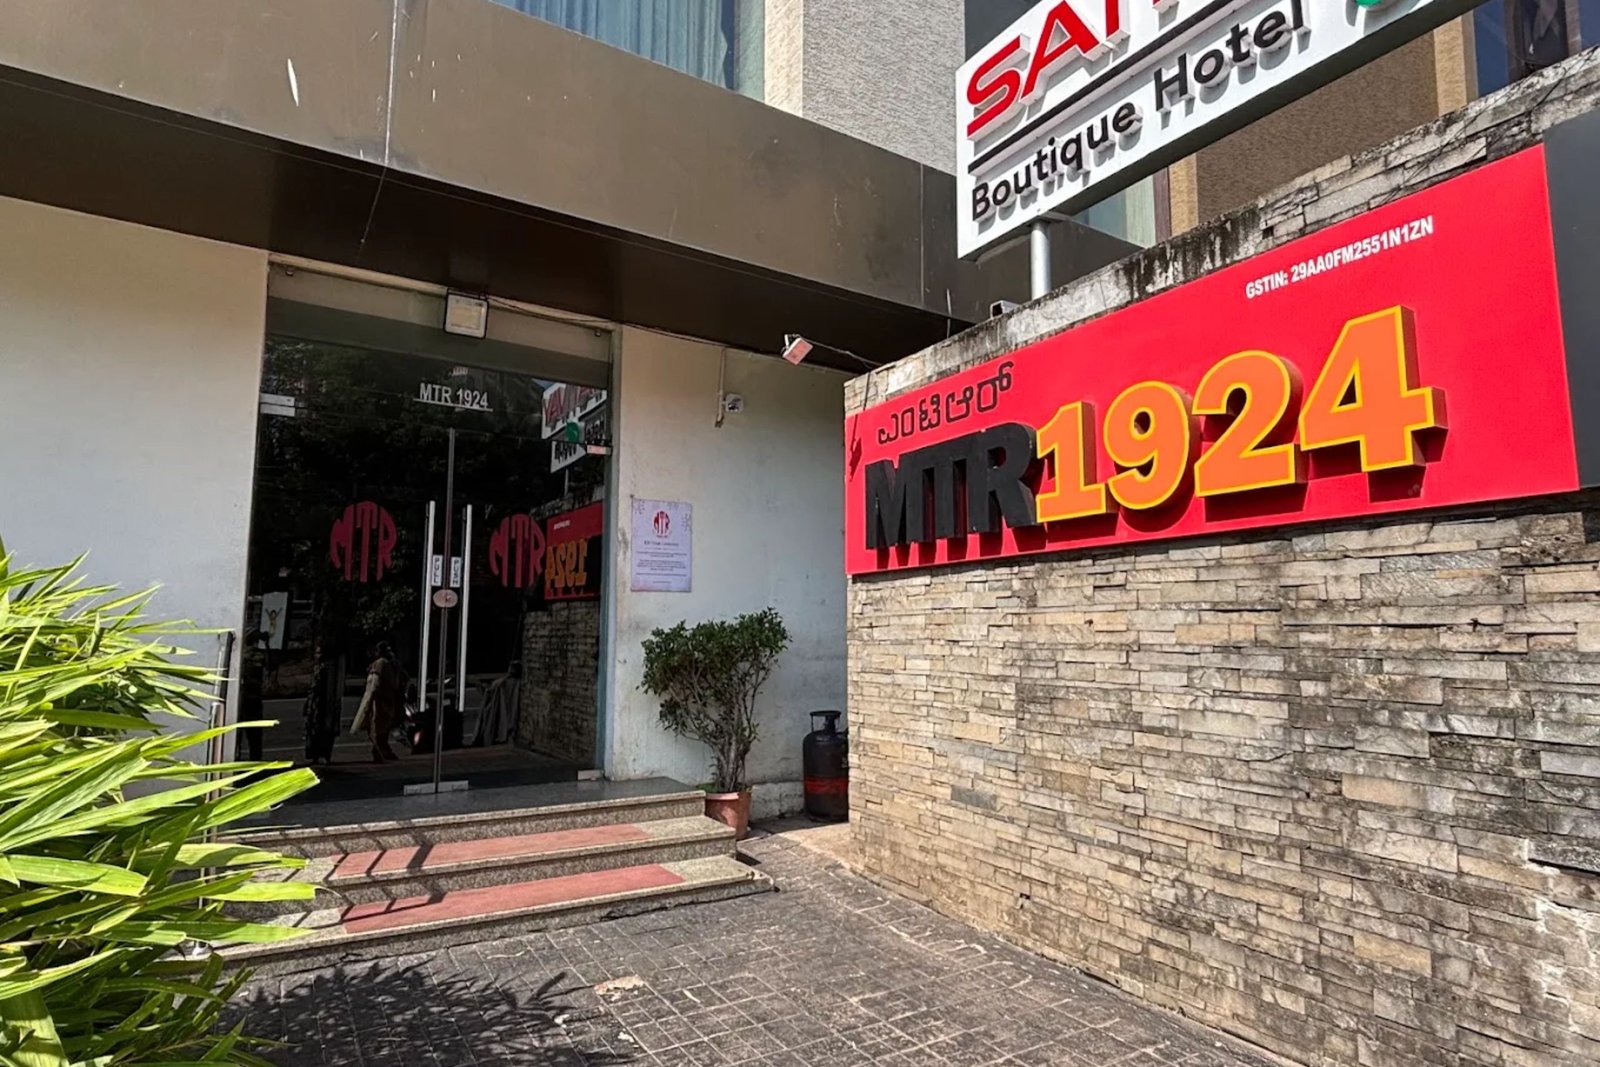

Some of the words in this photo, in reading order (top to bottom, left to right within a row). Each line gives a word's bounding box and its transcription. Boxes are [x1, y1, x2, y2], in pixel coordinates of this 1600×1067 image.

[972, 102, 1136, 221] Boutique
[1154, 0, 1304, 111] Hotel
[1245, 270, 1289, 299] GSTIN:
[420, 382, 453, 404] MTR
[456, 388, 489, 410] 1924
[865, 421, 1041, 550] MTR
[1035, 305, 1435, 524] 1924
[330, 501, 397, 583] MTR
[452, 558, 460, 585] PUSH
[489, 513, 546, 588] MTR
